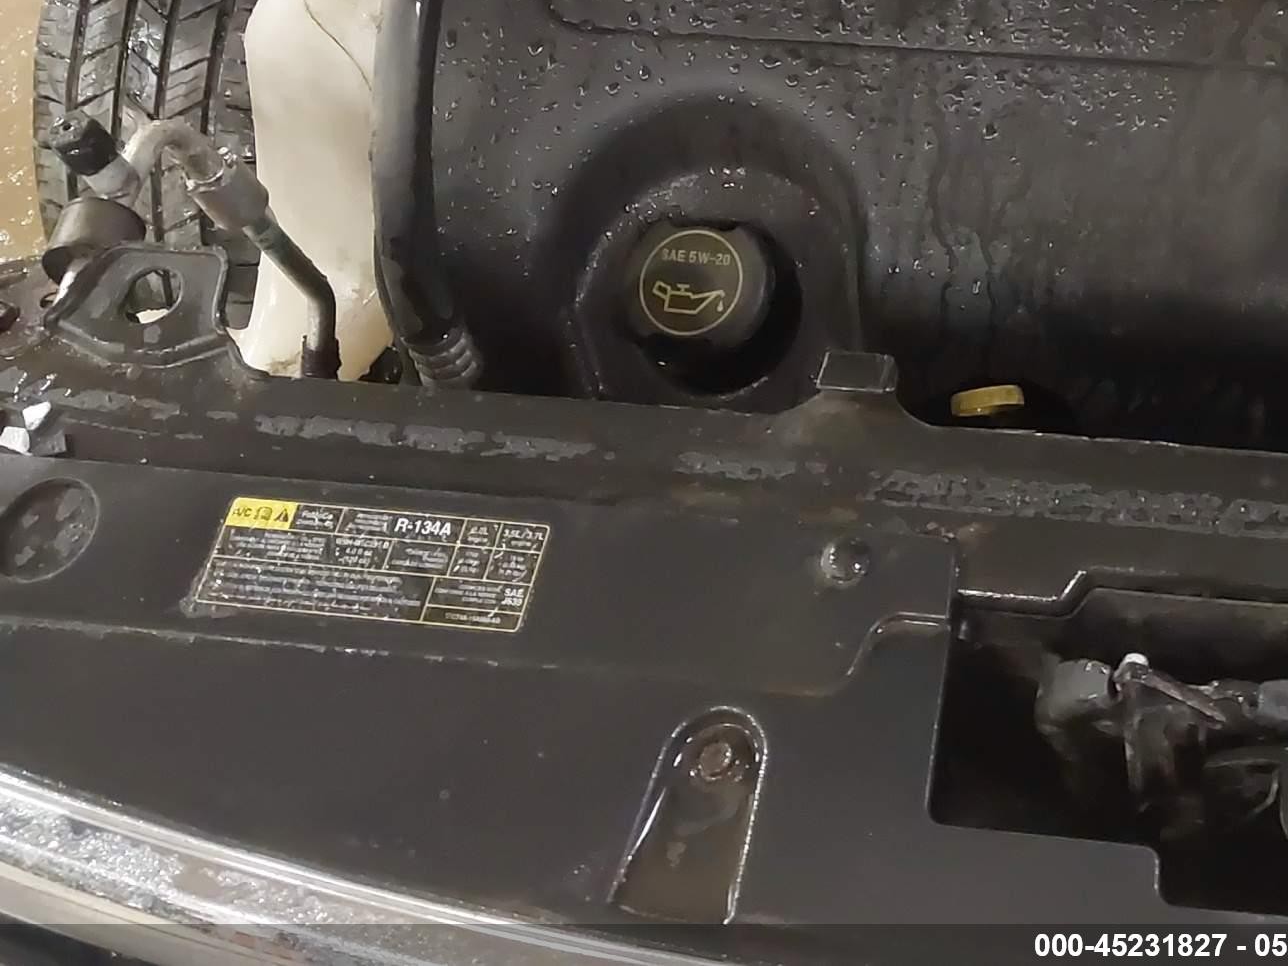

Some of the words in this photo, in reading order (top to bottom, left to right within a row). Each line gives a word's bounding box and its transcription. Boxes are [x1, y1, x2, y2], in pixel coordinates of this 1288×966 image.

[661, 248, 686, 263] SAE
[688, 250, 731, 266] 5W-20
[394, 518, 452, 536] R-134A
[504, 588, 524, 598] SAE
